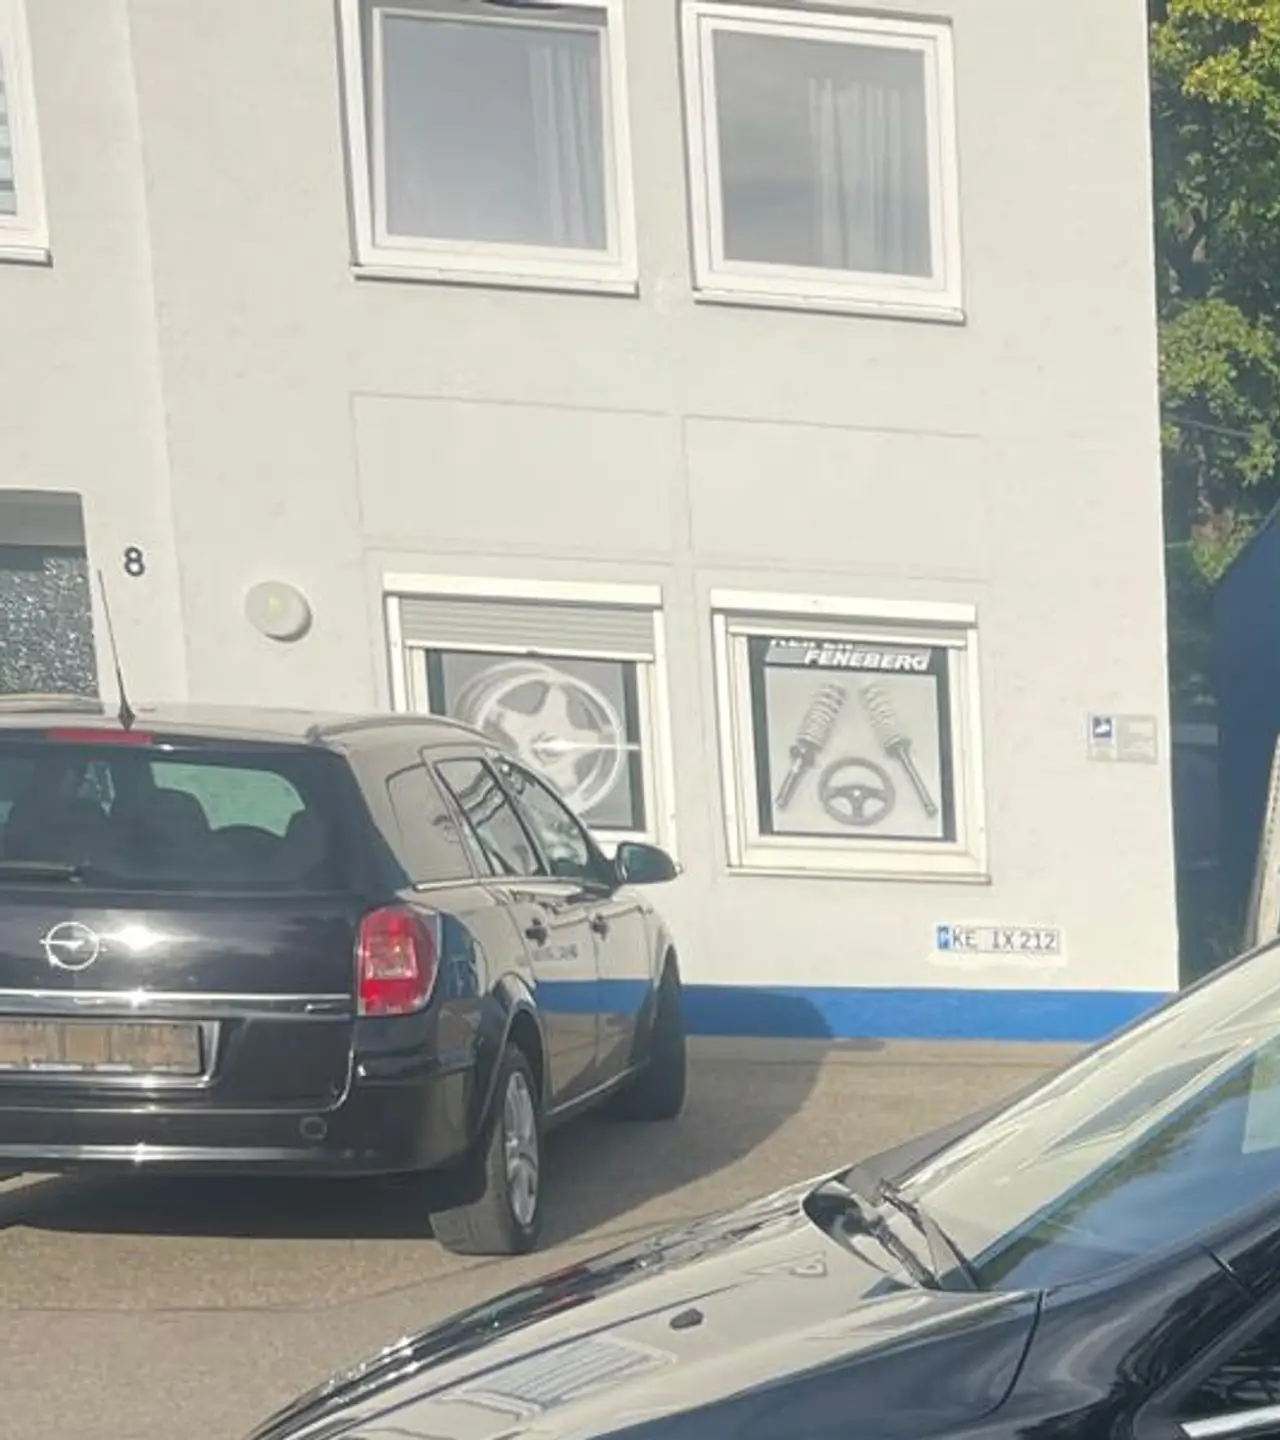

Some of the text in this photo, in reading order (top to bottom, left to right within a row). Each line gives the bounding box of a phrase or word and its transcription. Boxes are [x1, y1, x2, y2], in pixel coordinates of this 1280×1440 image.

[124, 546, 145, 577] 8
[804, 649, 930, 671] FENEBERG
[953, 926, 977, 948] KE
[1020, 931, 1056, 950] 212
